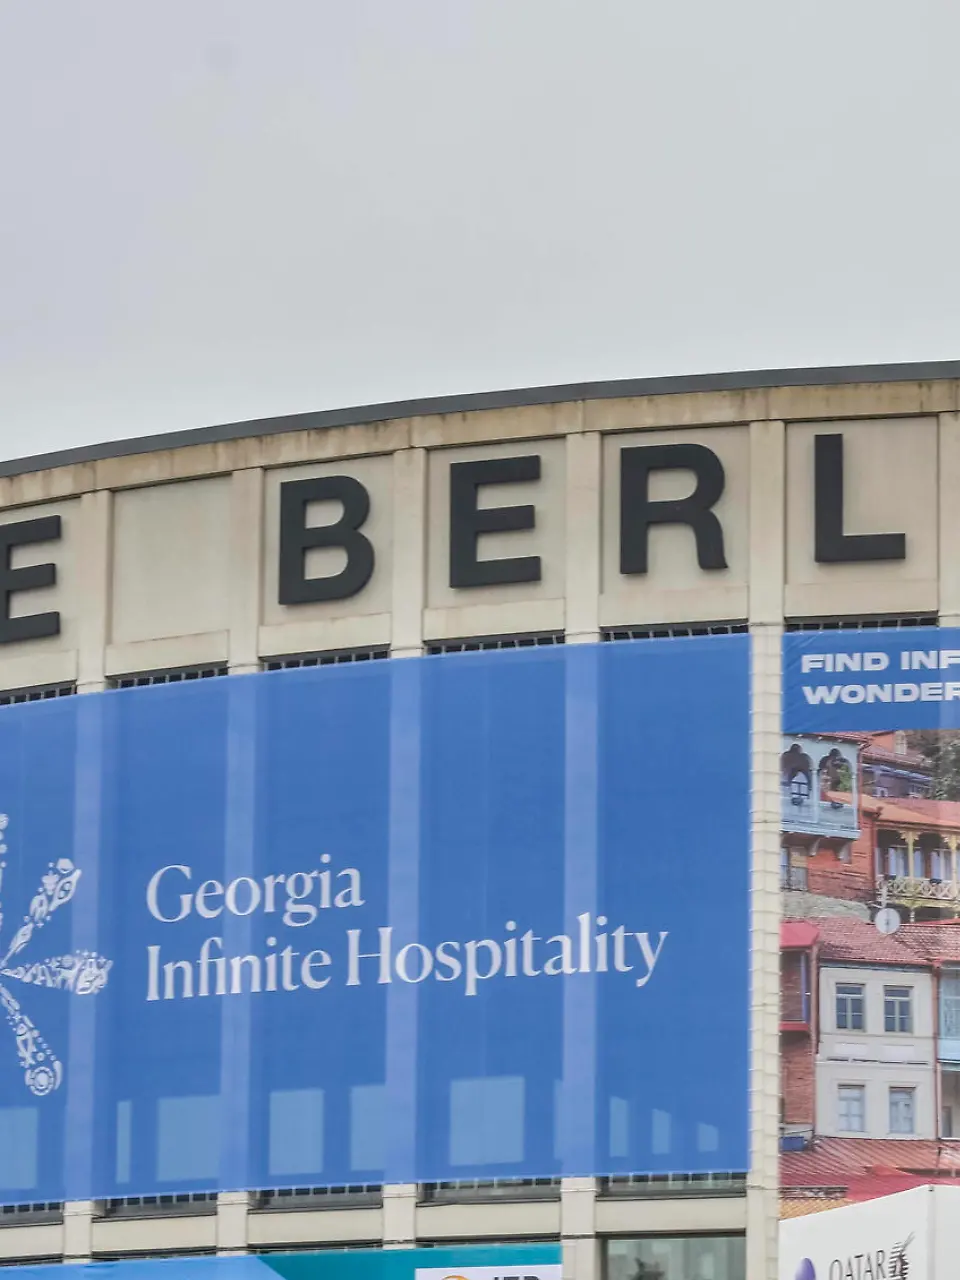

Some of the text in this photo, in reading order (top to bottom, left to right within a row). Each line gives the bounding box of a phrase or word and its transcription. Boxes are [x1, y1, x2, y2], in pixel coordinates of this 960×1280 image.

[801, 651, 890, 674] FIND
[146, 854, 365, 927] Georgia
[146, 912, 669, 1001] Infinite Hospitality
